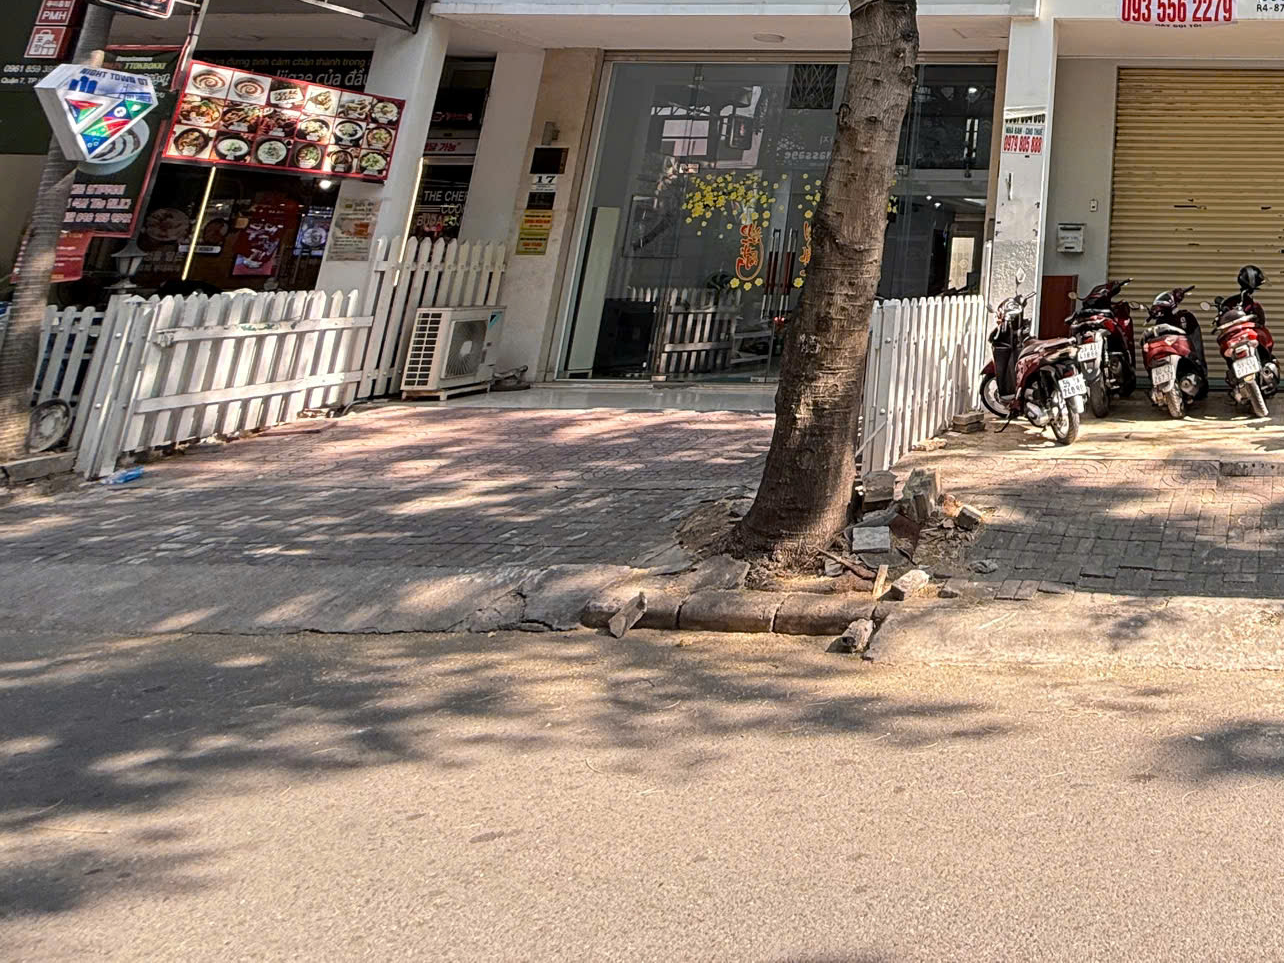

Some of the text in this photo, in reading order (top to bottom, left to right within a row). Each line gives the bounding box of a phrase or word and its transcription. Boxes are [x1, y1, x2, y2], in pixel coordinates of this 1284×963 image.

[41, 10, 68, 20] PMH
[80, 67, 108, 78] NIGHT
[537, 175, 556, 184] 17
[423, 190, 443, 202] THE
